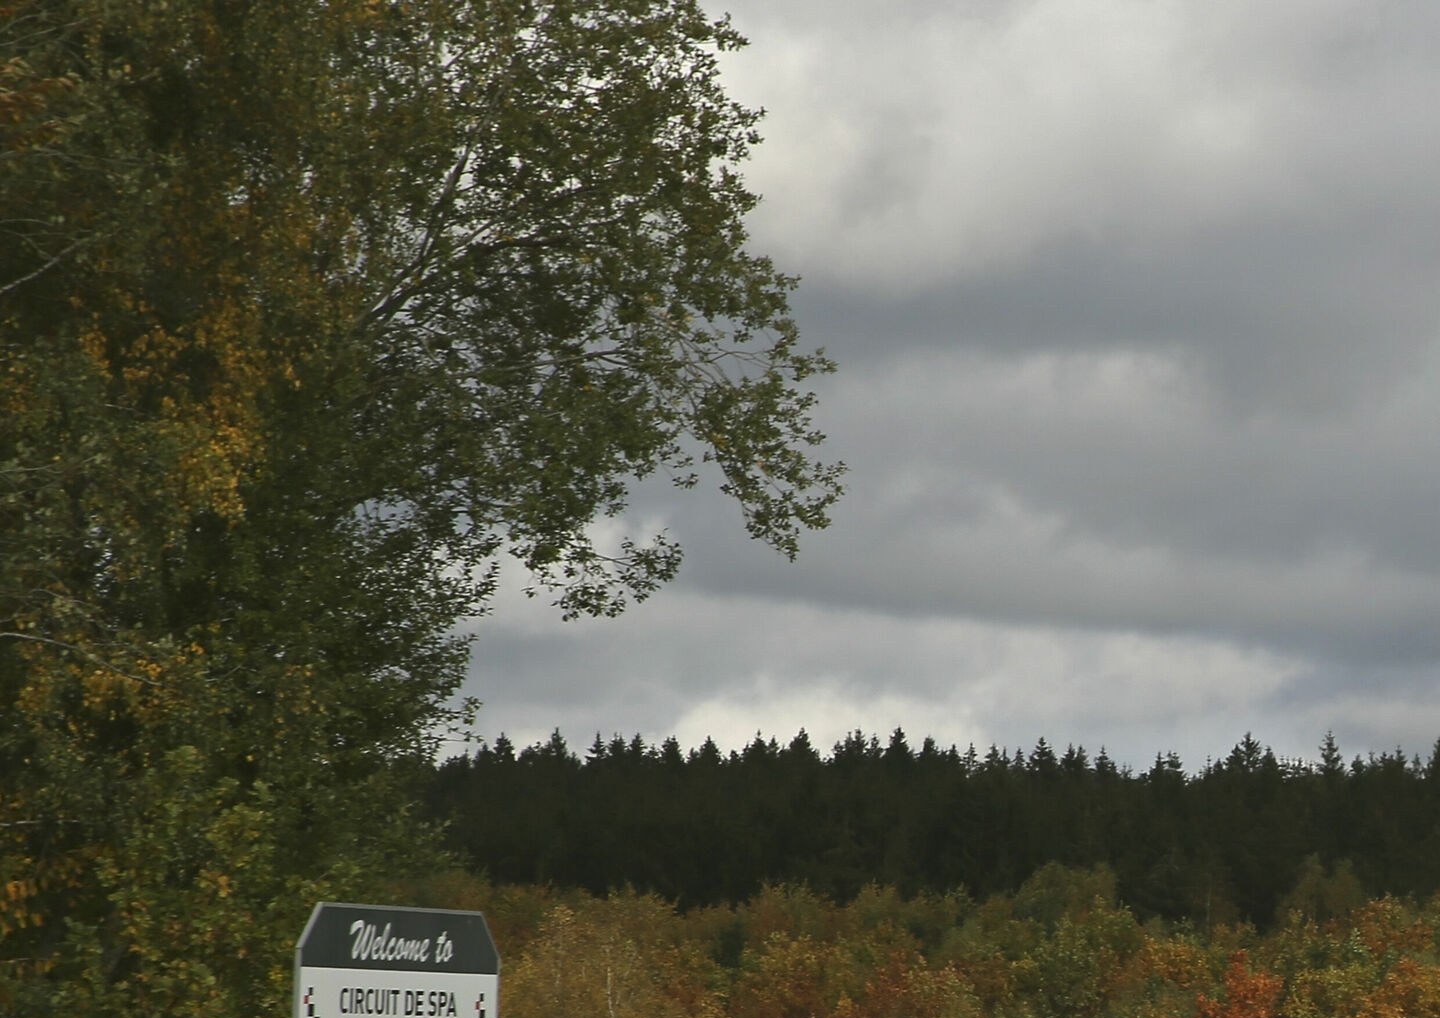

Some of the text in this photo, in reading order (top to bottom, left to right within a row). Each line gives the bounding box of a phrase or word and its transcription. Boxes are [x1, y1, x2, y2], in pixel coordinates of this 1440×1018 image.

[350, 920, 453, 964] Welcome to
[339, 987, 458, 1017] CIRCUIT DE SPA
